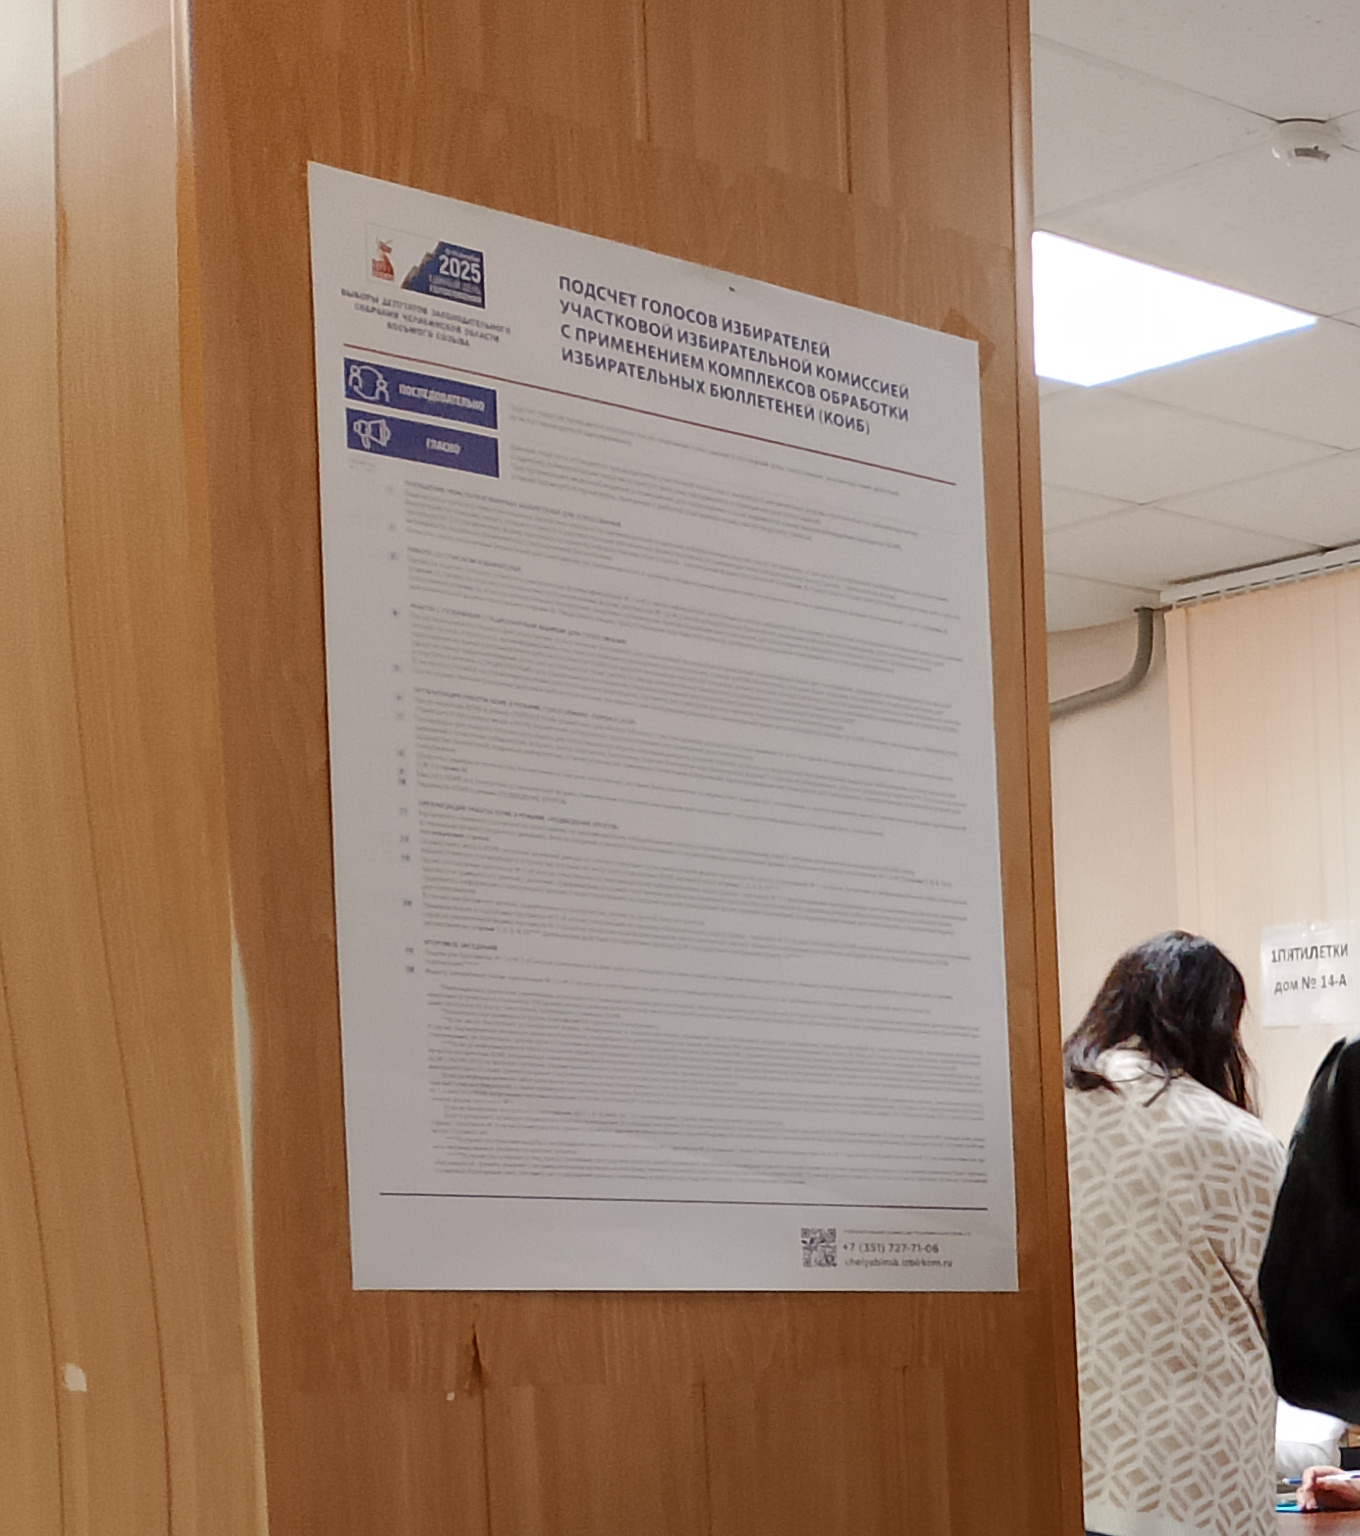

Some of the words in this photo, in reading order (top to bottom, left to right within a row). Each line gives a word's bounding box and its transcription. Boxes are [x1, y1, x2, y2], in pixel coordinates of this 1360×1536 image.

[438, 254, 482, 284] 2025
[558, 275, 638, 308] ПОДСЧЕТ
[641, 297, 718, 329] ГОЛОСОВ
[721, 317, 830, 358] ИЗБИРАТЕЛЕЙ
[559, 299, 673, 340] УЧАСТКОВОЙ
[677, 328, 812, 376] ИЗБИРАТЕЛЬНОЙ
[816, 364, 909, 400] КОМИССИЕЙ
[560, 323, 571, 339] С
[575, 327, 704, 372] ПРИМЕНЕНИЕМ
[708, 360, 816, 399] КОМПЛЕКСОВ
[819, 388, 909, 422] ОБРАБОТКИ
[561, 347, 706, 395] ИЗБИРАТЕЛЬНЫХ
[710, 383, 815, 421] БЮЛЛЕТЕНЕЙ
[819, 409, 870, 435] (КОИБ)
[1301, 975, 1317, 990] №
